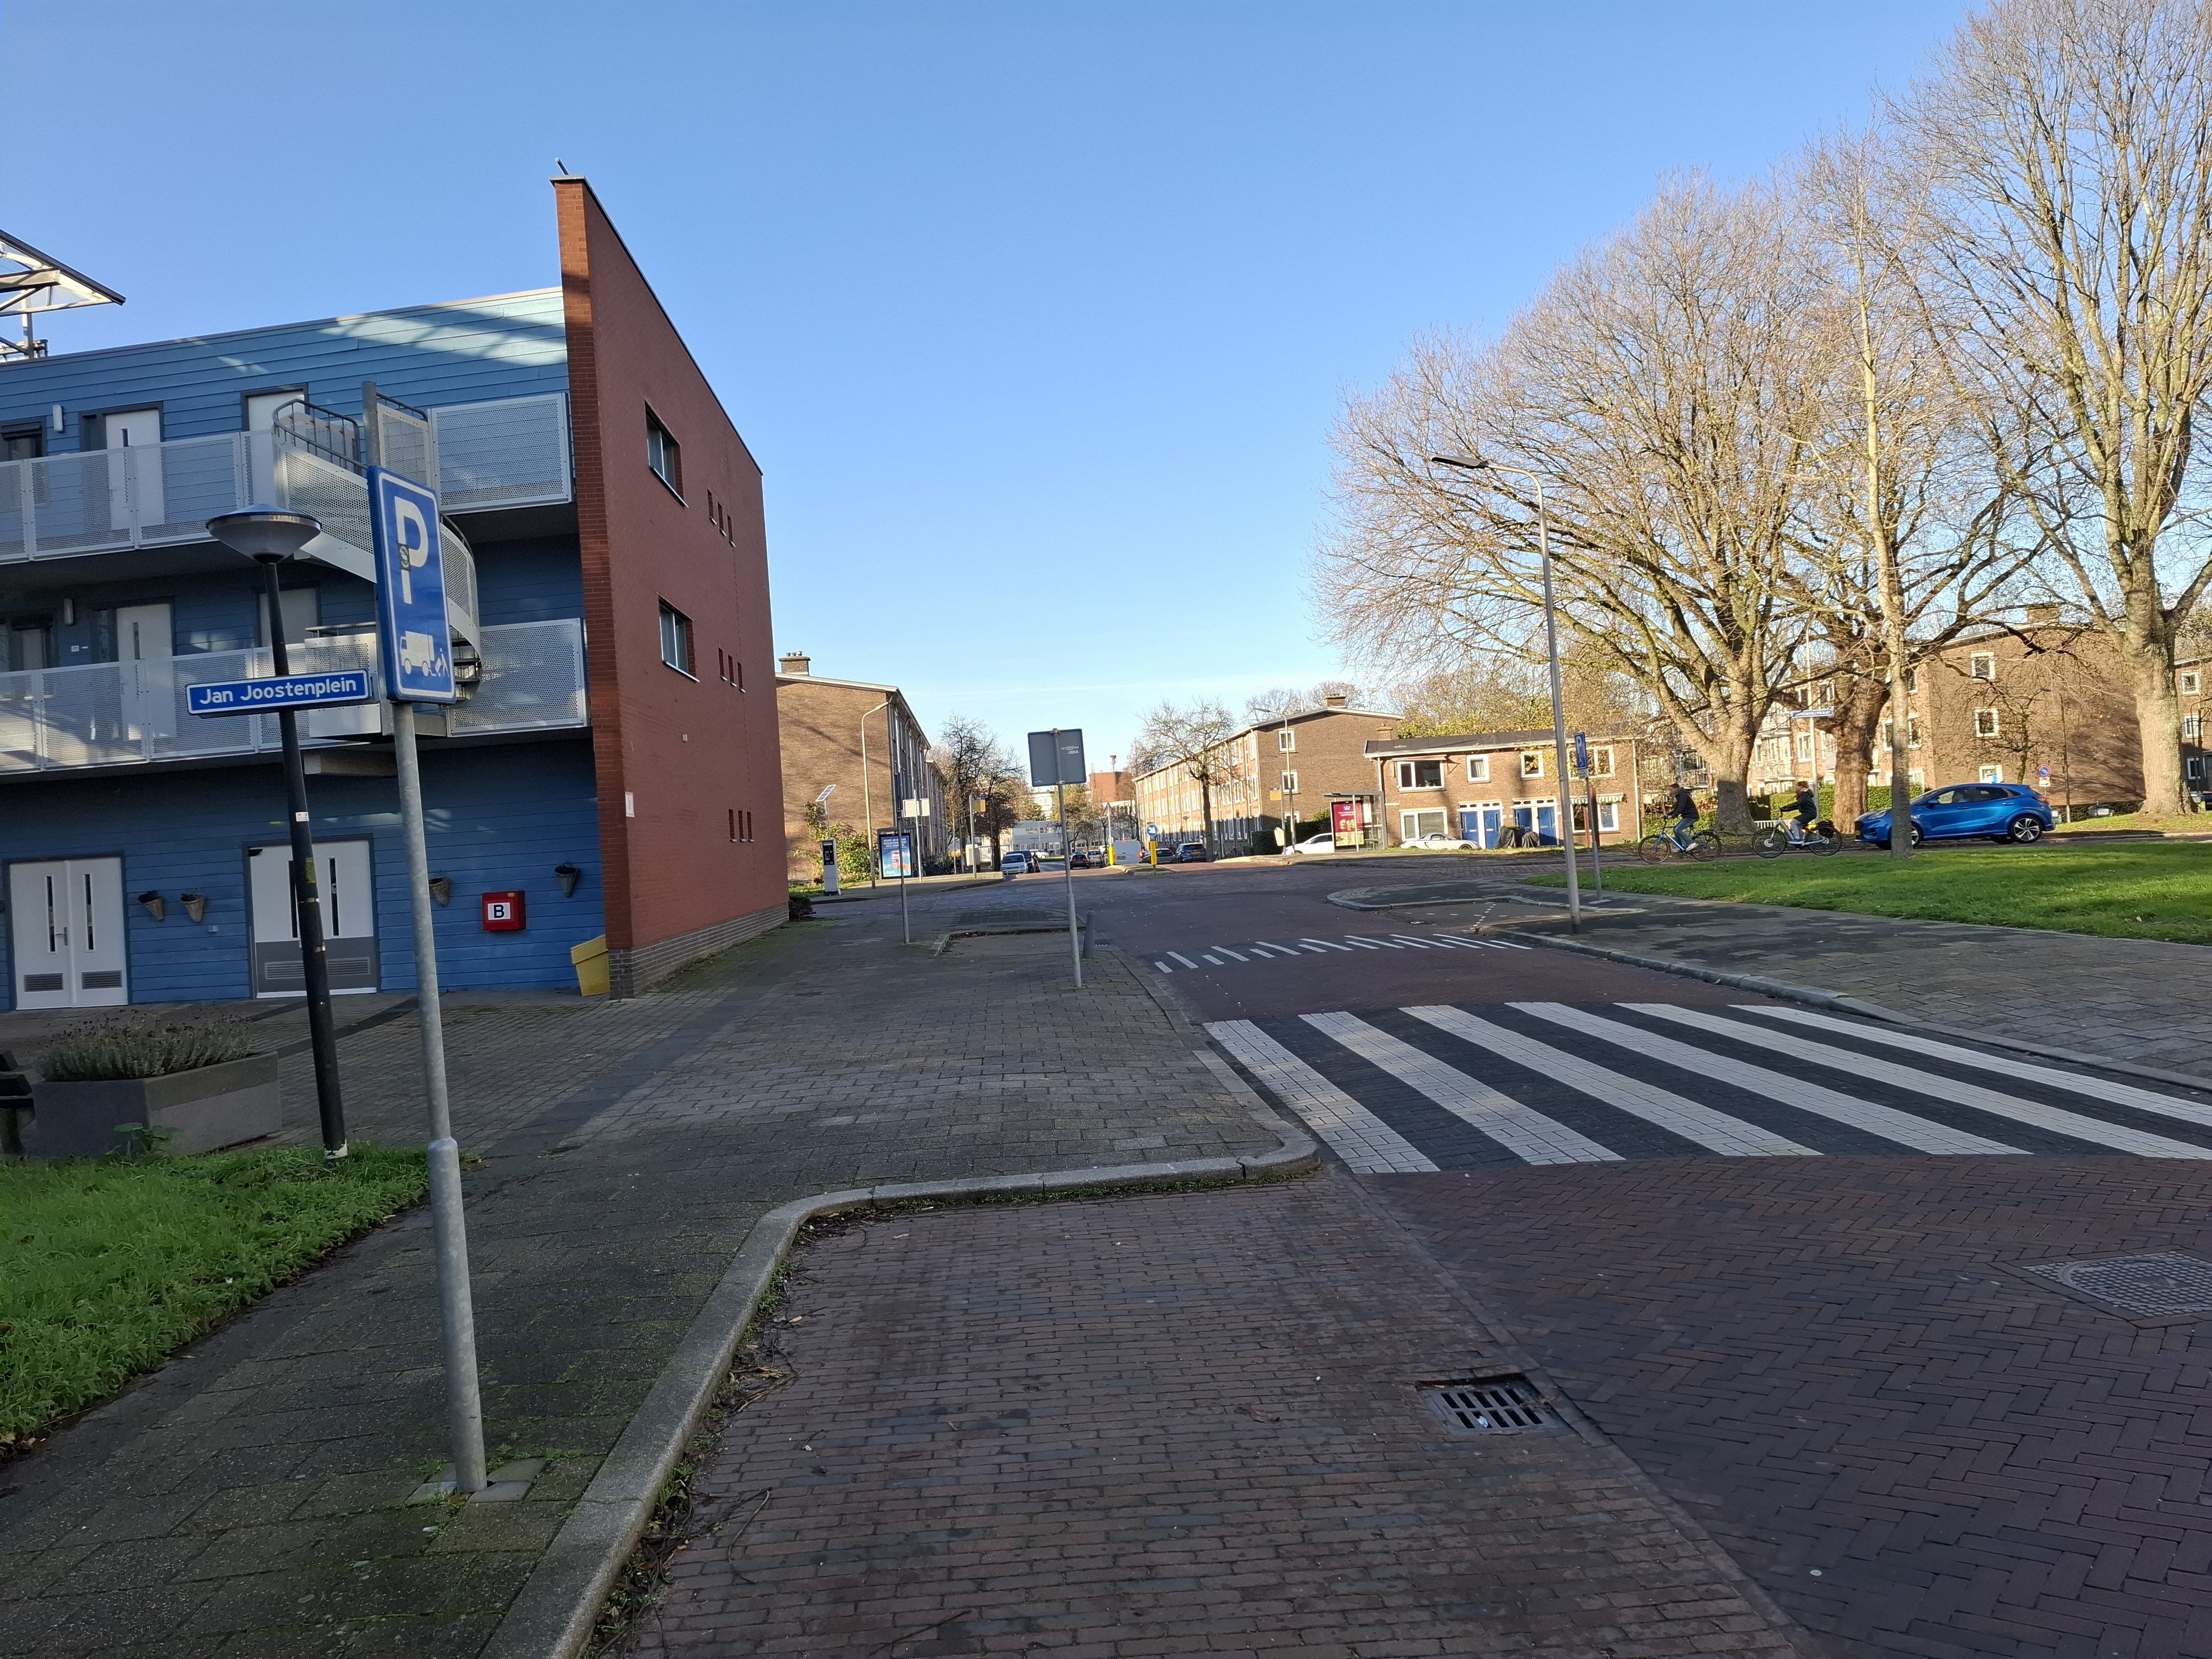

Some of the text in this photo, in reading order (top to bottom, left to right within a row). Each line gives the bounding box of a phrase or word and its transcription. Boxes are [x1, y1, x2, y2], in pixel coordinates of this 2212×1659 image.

[394, 496, 429, 605] P
[199, 677, 357, 704] Jan Joostenplein
[1576, 736, 1582, 754] P
[493, 904, 505, 918] B
